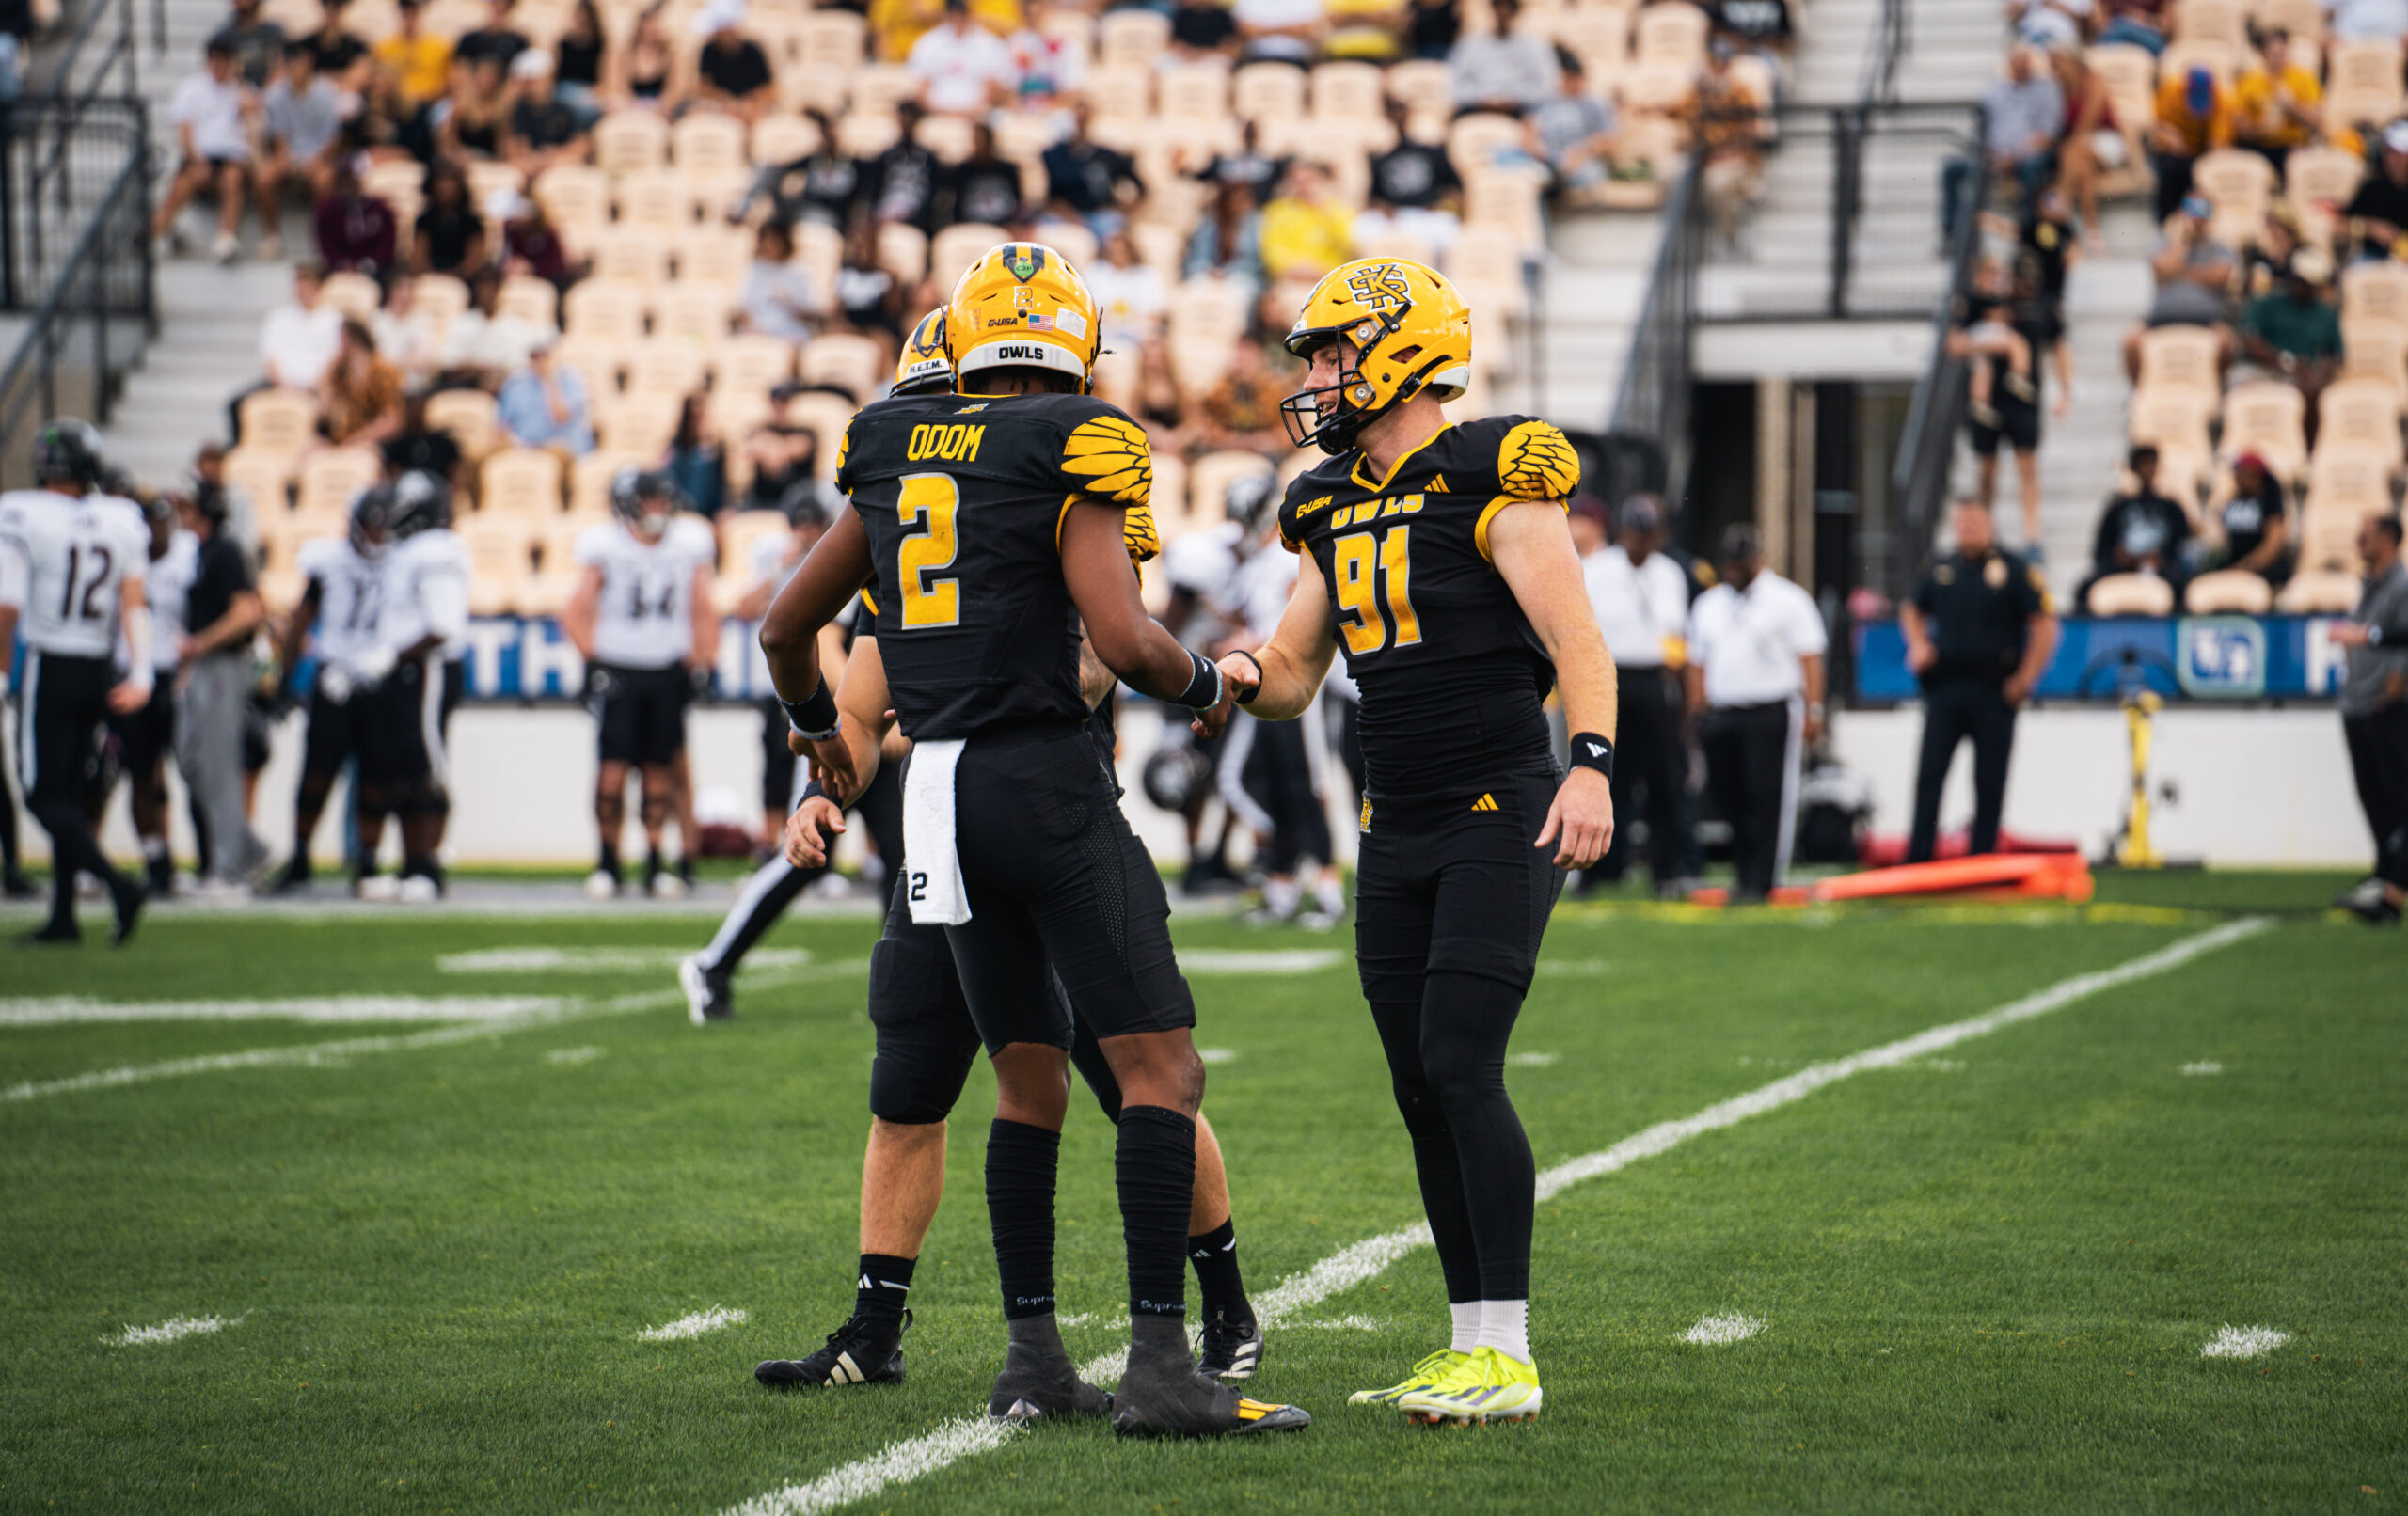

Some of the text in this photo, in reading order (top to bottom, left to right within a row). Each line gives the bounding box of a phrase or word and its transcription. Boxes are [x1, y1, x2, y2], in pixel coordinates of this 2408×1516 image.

[1014, 286, 1033, 308] 2
[910, 360, 943, 373] H.E.T.M.
[999, 346, 1043, 360] OWLS
[907, 424, 987, 462] ODOM
[1330, 493, 1425, 530] OWLS
[897, 472, 960, 630] 2
[61, 545, 112, 621] 12
[1334, 524, 1422, 655] 91
[911, 871, 928, 901] 2
